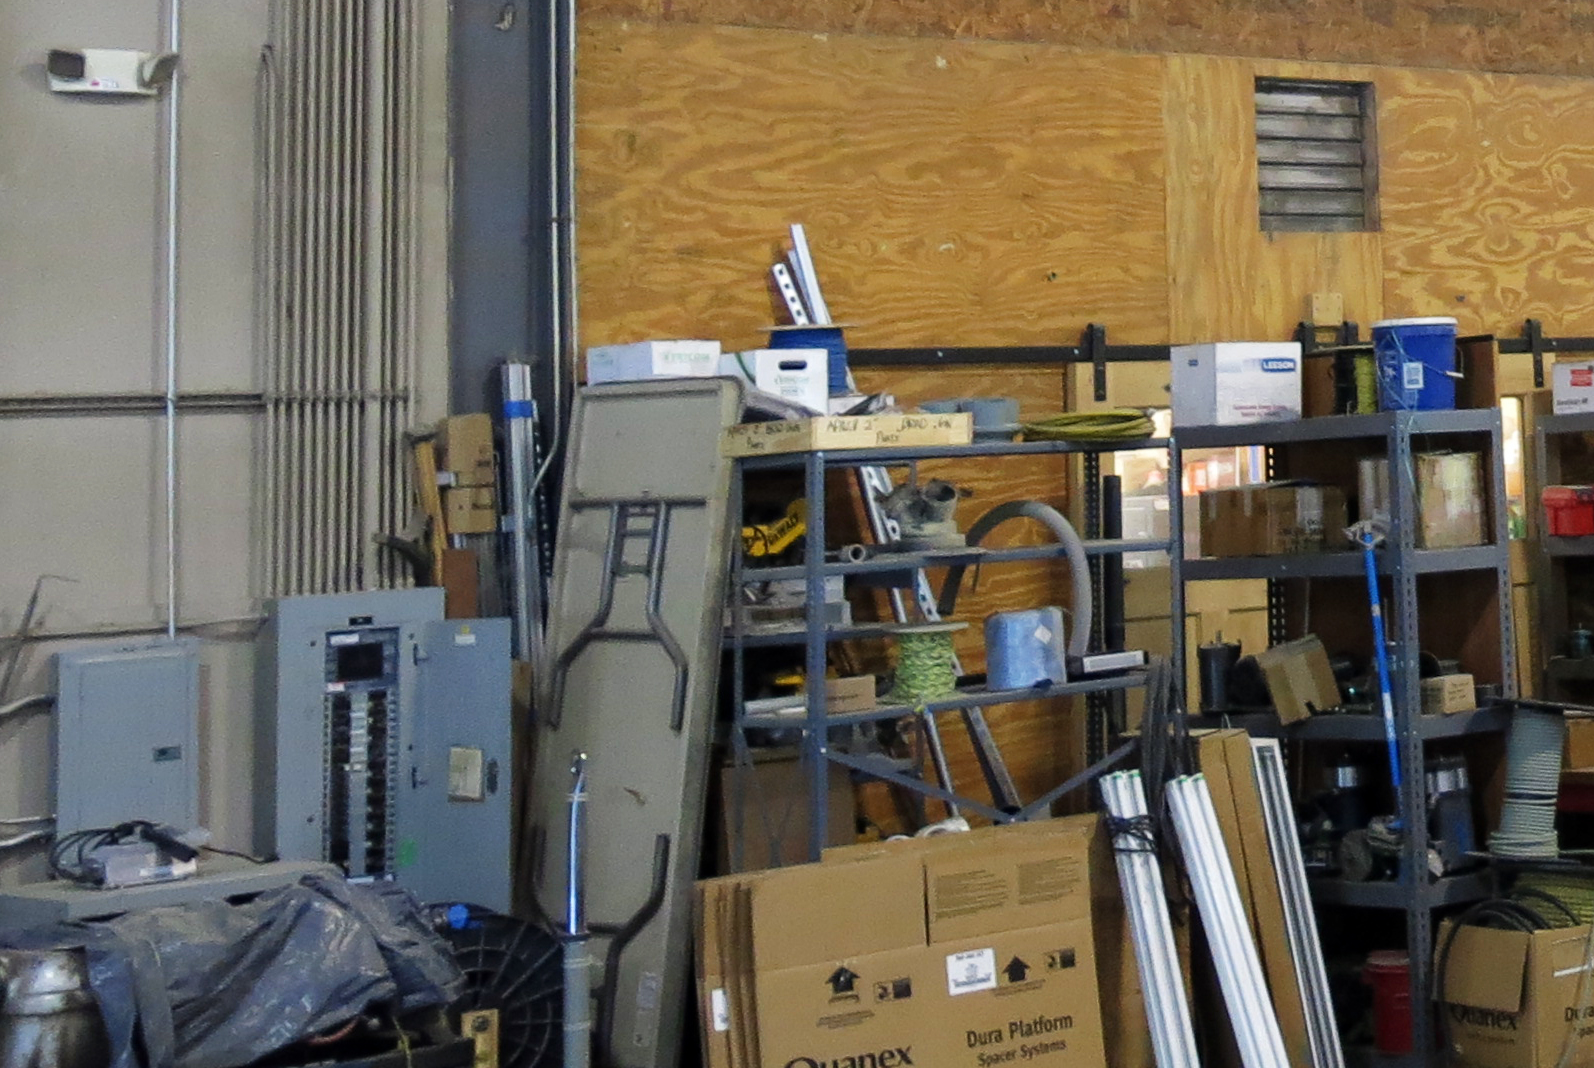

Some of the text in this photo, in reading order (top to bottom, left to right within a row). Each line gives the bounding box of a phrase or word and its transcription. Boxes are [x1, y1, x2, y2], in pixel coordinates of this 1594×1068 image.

[966, 1013, 1074, 1049] Dura Platform
[977, 1038, 1067, 1068] Spacer Systems
